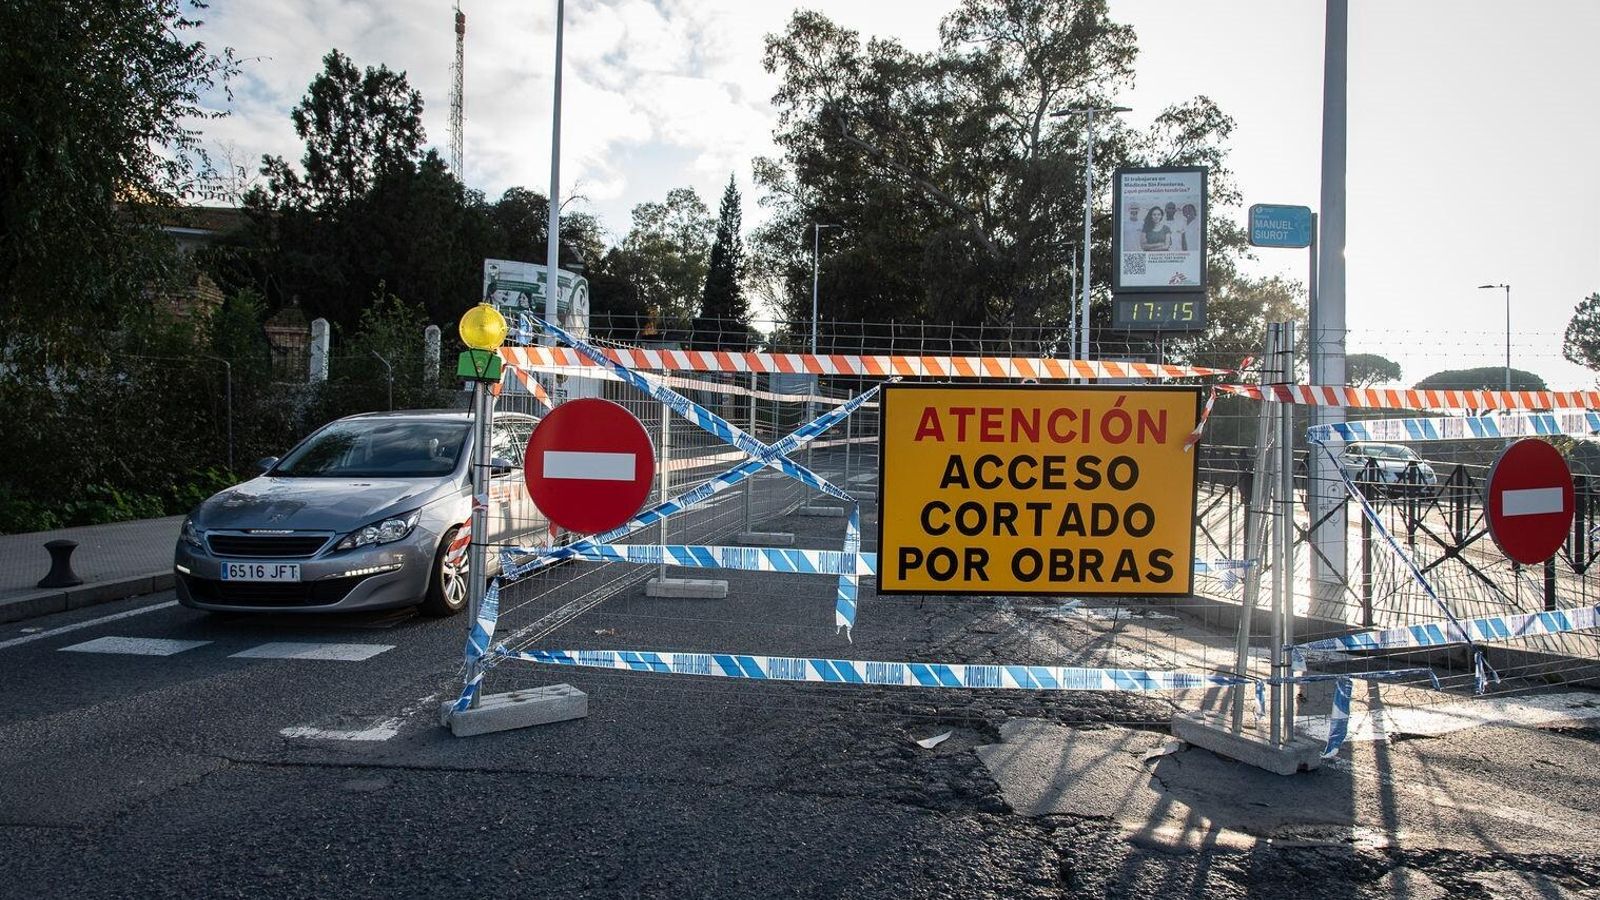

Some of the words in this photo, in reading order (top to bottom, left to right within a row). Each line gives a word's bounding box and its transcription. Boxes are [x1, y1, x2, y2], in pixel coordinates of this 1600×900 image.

[1255, 220, 1295, 230] MANUEL
[1255, 230, 1289, 240] SIUROT
[1133, 303, 1193, 321] 17:15
[914, 395, 1167, 444] ATENCIÓN
[939, 454, 1139, 491] ACCESO
[920, 500, 1156, 538] CORTADO
[230, 565, 264, 578] 6516
[271, 565, 297, 579] JFT
[898, 546, 990, 582] POR
[1011, 547, 1174, 583] OBRAS
